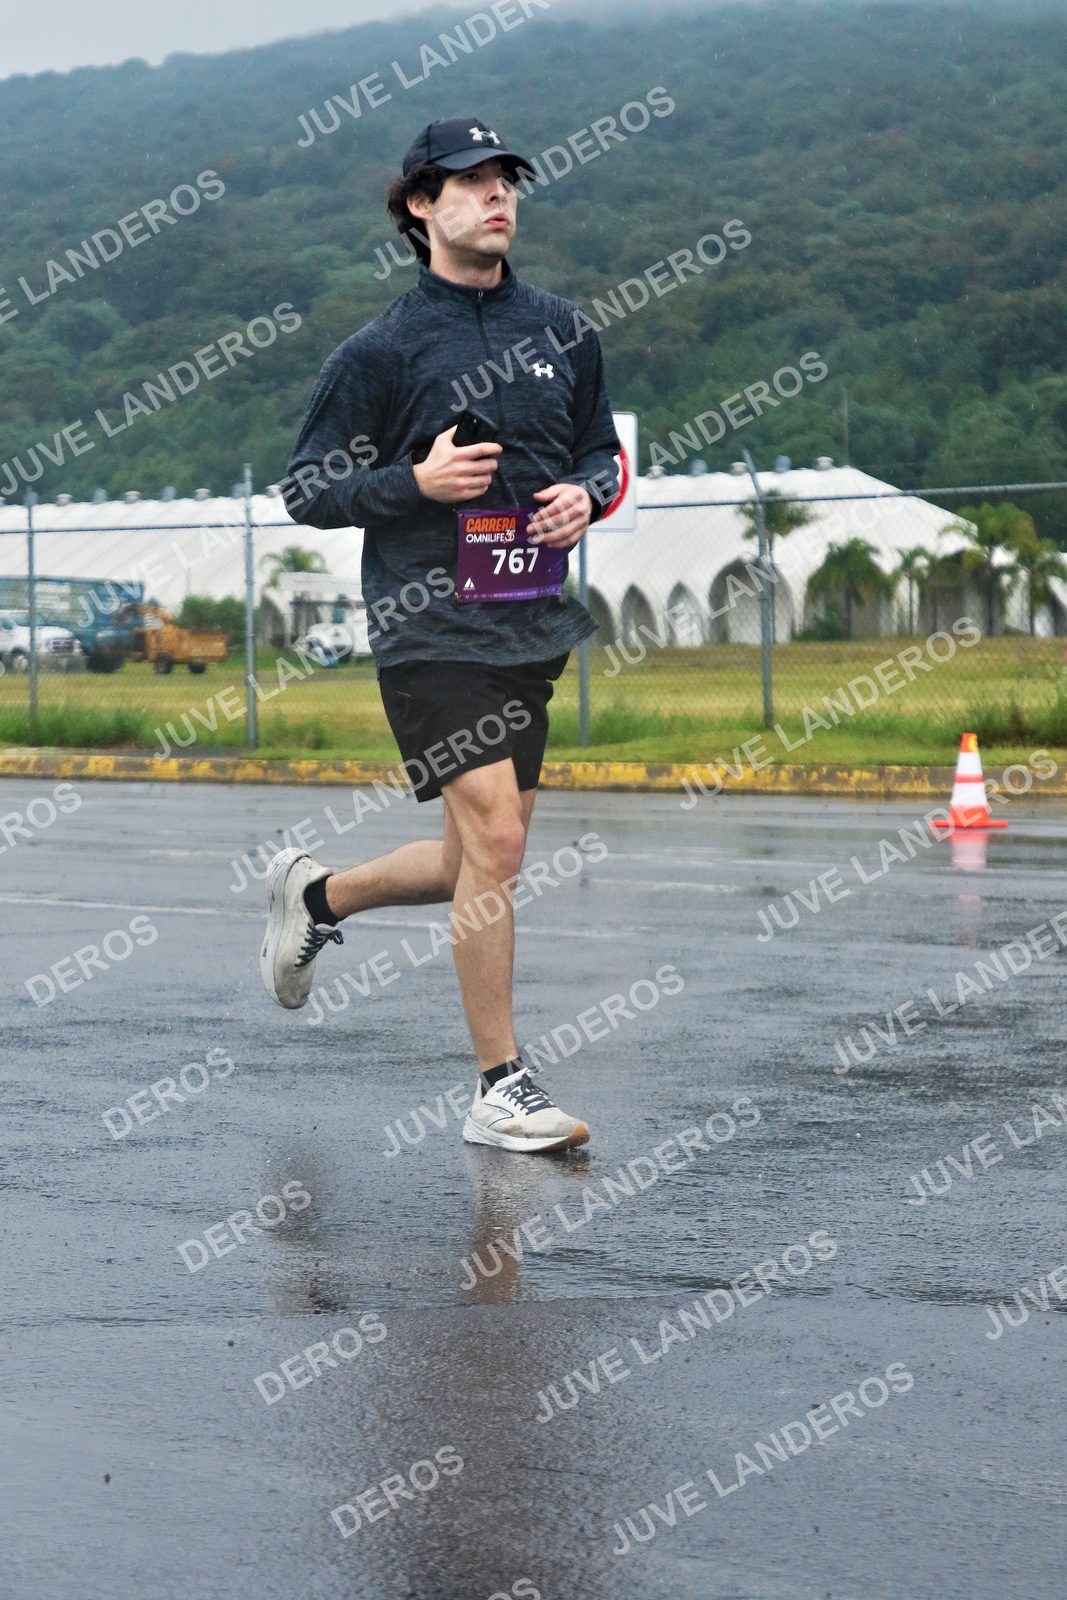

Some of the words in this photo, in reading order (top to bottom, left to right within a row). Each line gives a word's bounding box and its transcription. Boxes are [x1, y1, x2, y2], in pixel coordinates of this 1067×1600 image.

[466, 517, 517, 533] CARRERA
[466, 533, 505, 543] OMNILIFE
[492, 547, 539, 575] 767
